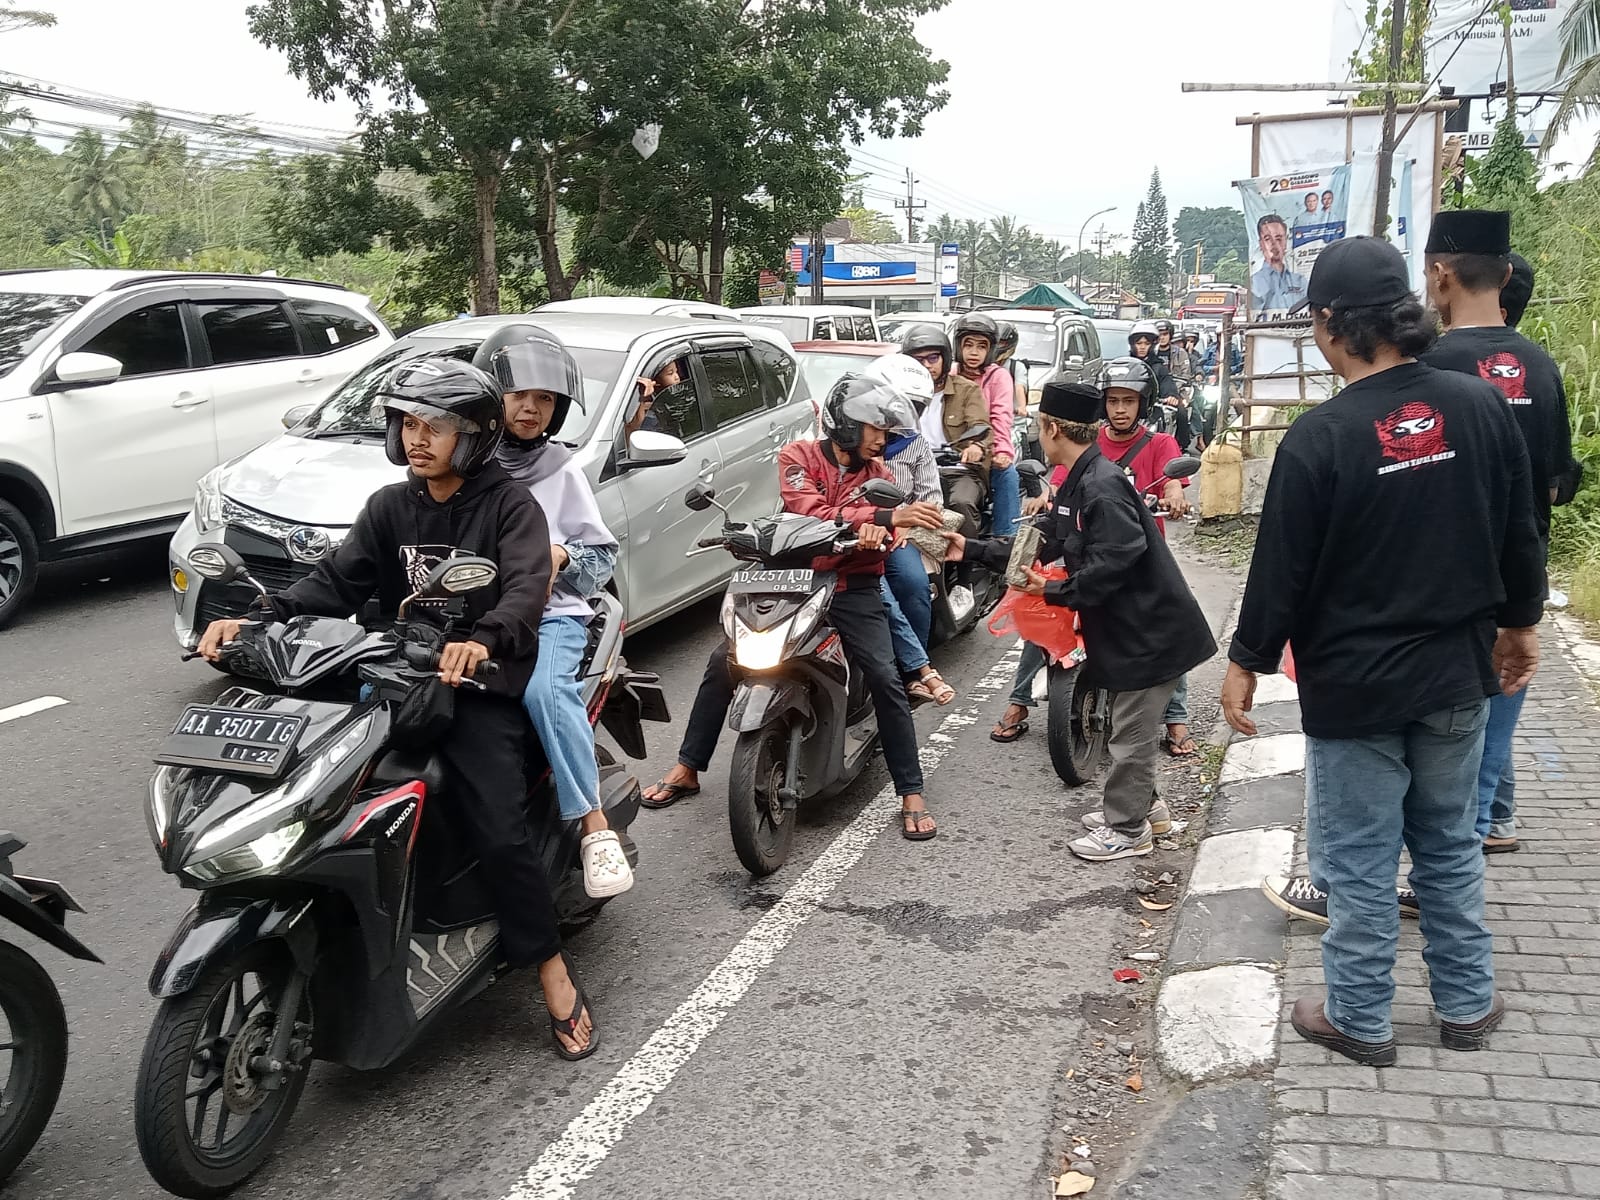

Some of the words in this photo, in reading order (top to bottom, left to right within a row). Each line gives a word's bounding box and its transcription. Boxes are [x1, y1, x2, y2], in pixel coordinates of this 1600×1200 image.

[1514, 13, 1546, 23] Peduli
[1289, 173, 1319, 181] PRABOWO
[732, 571, 749, 583] AD
[750, 570, 785, 583] 4457
[787, 569, 813, 583] AJD
[291, 639, 323, 649] HONDA
[181, 713, 210, 734] AA
[214, 717, 266, 739] 3507
[266, 721, 295, 742] IG
[384, 802, 416, 838] HONDA
